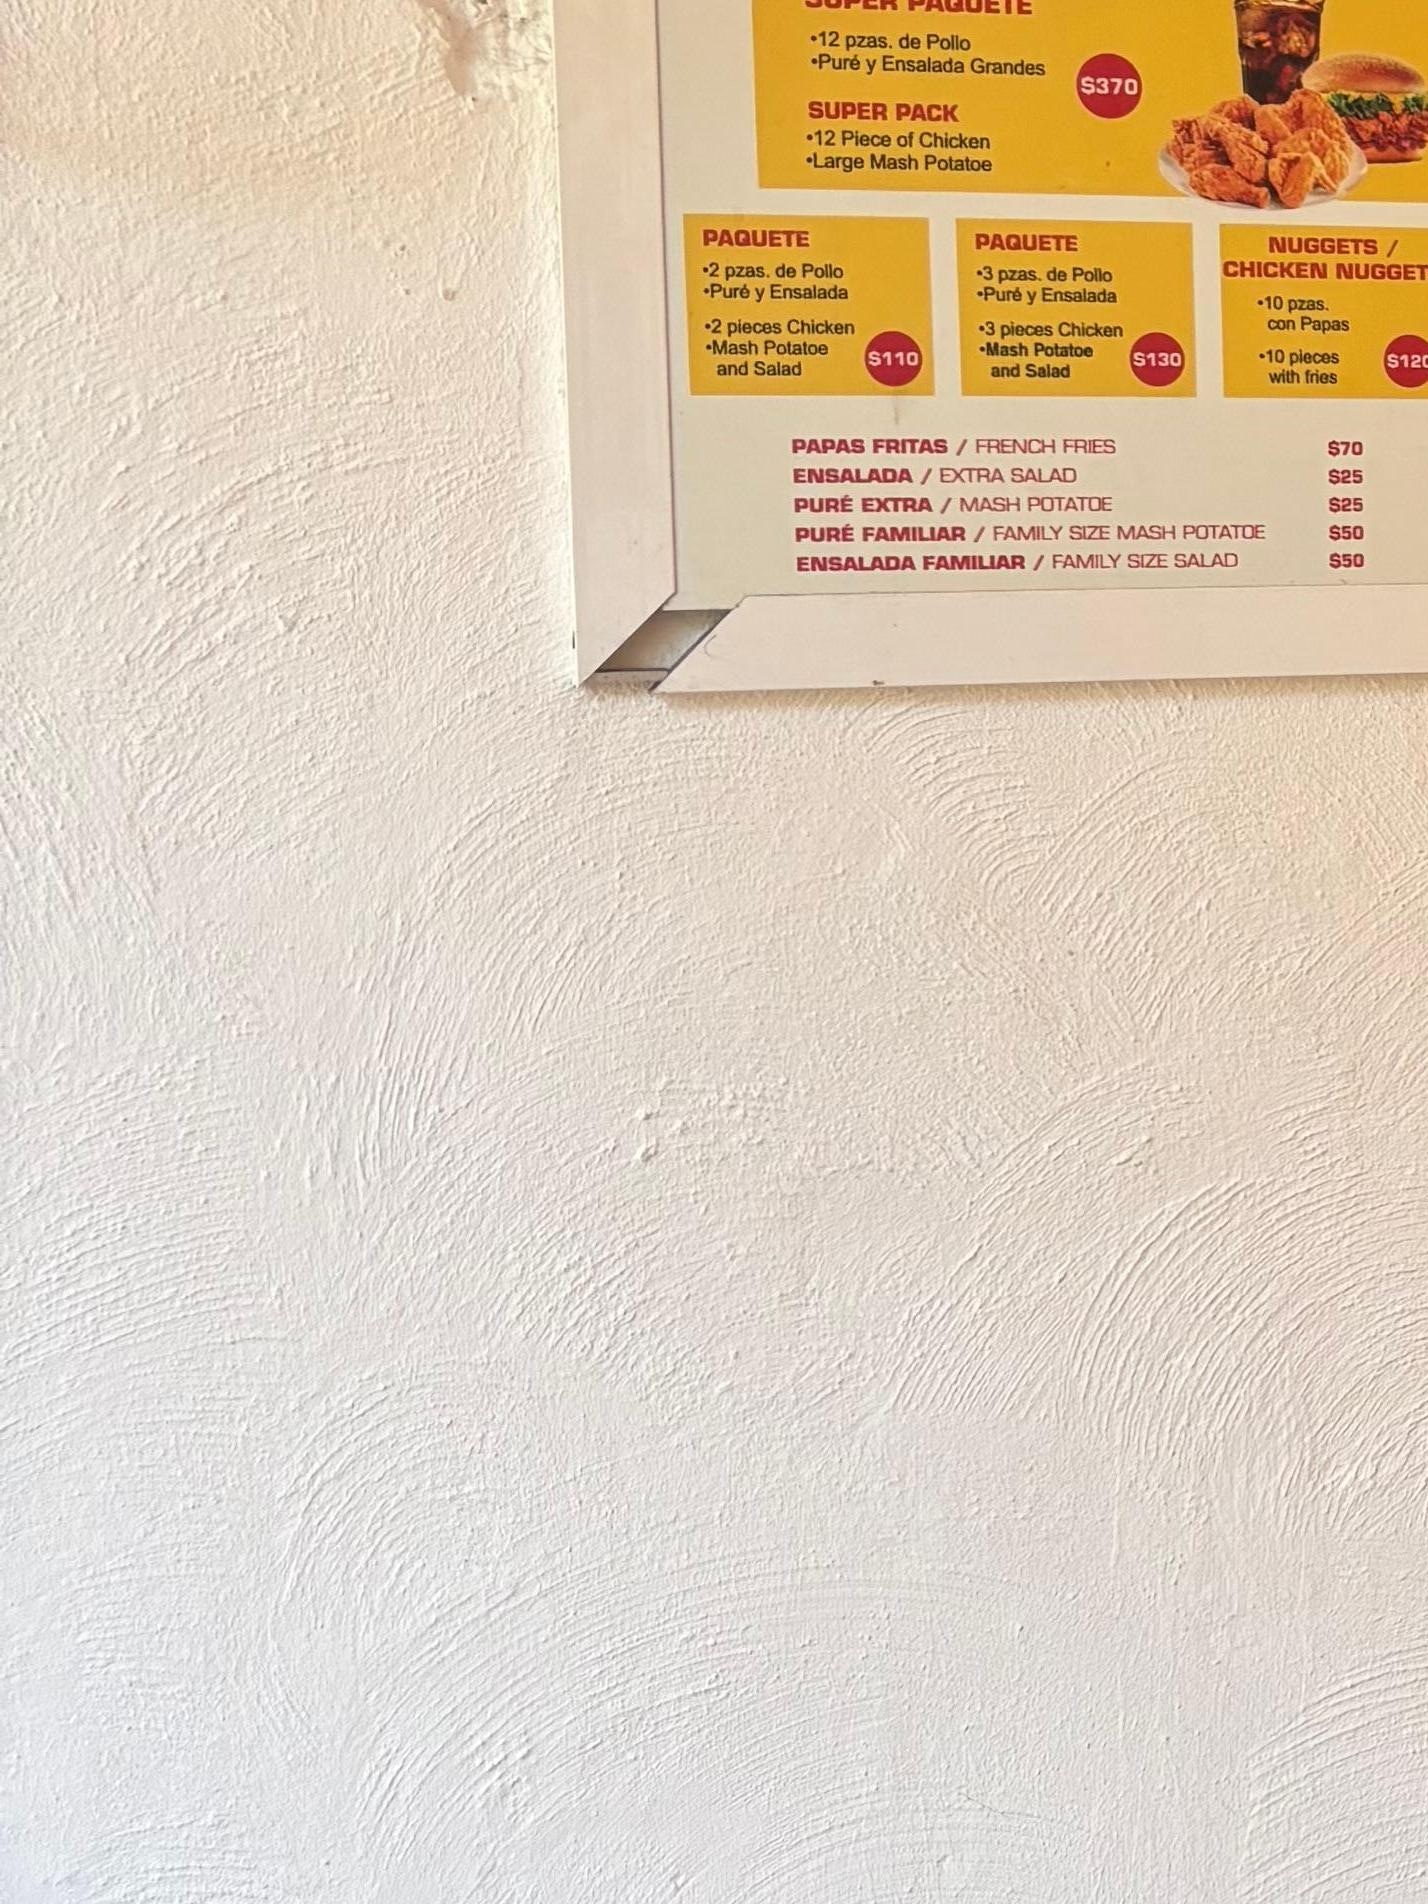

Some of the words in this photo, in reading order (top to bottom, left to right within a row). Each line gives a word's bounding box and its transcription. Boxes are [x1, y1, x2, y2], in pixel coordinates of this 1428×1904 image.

[1080, 76, 1138, 95] $370
[808, 101, 888, 121] SUPER
[895, 103, 959, 122] PACK
[841, 130, 891, 147] Piece
[896, 131, 914, 148] of
[918, 131, 990, 149] Chicken
[870, 153, 919, 170] Mash
[924, 154, 992, 172] Potatoe
[702, 229, 810, 247] PAQUETE
[975, 233, 1078, 251] PAQUETE
[1268, 236, 1378, 255] NUGGETS
[1222, 260, 1328, 279] CHICKEN
[868, 350, 919, 366] $110
[1133, 351, 1182, 367] $130
[716, 360, 748, 376] and
[754, 360, 802, 376] Salad
[791, 438, 865, 454] PAPAS
[872, 438, 948, 454] FRITAS
[975, 438, 1056, 454] FRENCH
[1062, 438, 1116, 454] FRIES
[1327, 440, 1363, 457] $70
[792, 467, 913, 484] ENSALADA
[939, 467, 1005, 483] EXTRA
[1010, 467, 1077, 483] SALAD
[1328, 468, 1363, 485] $25
